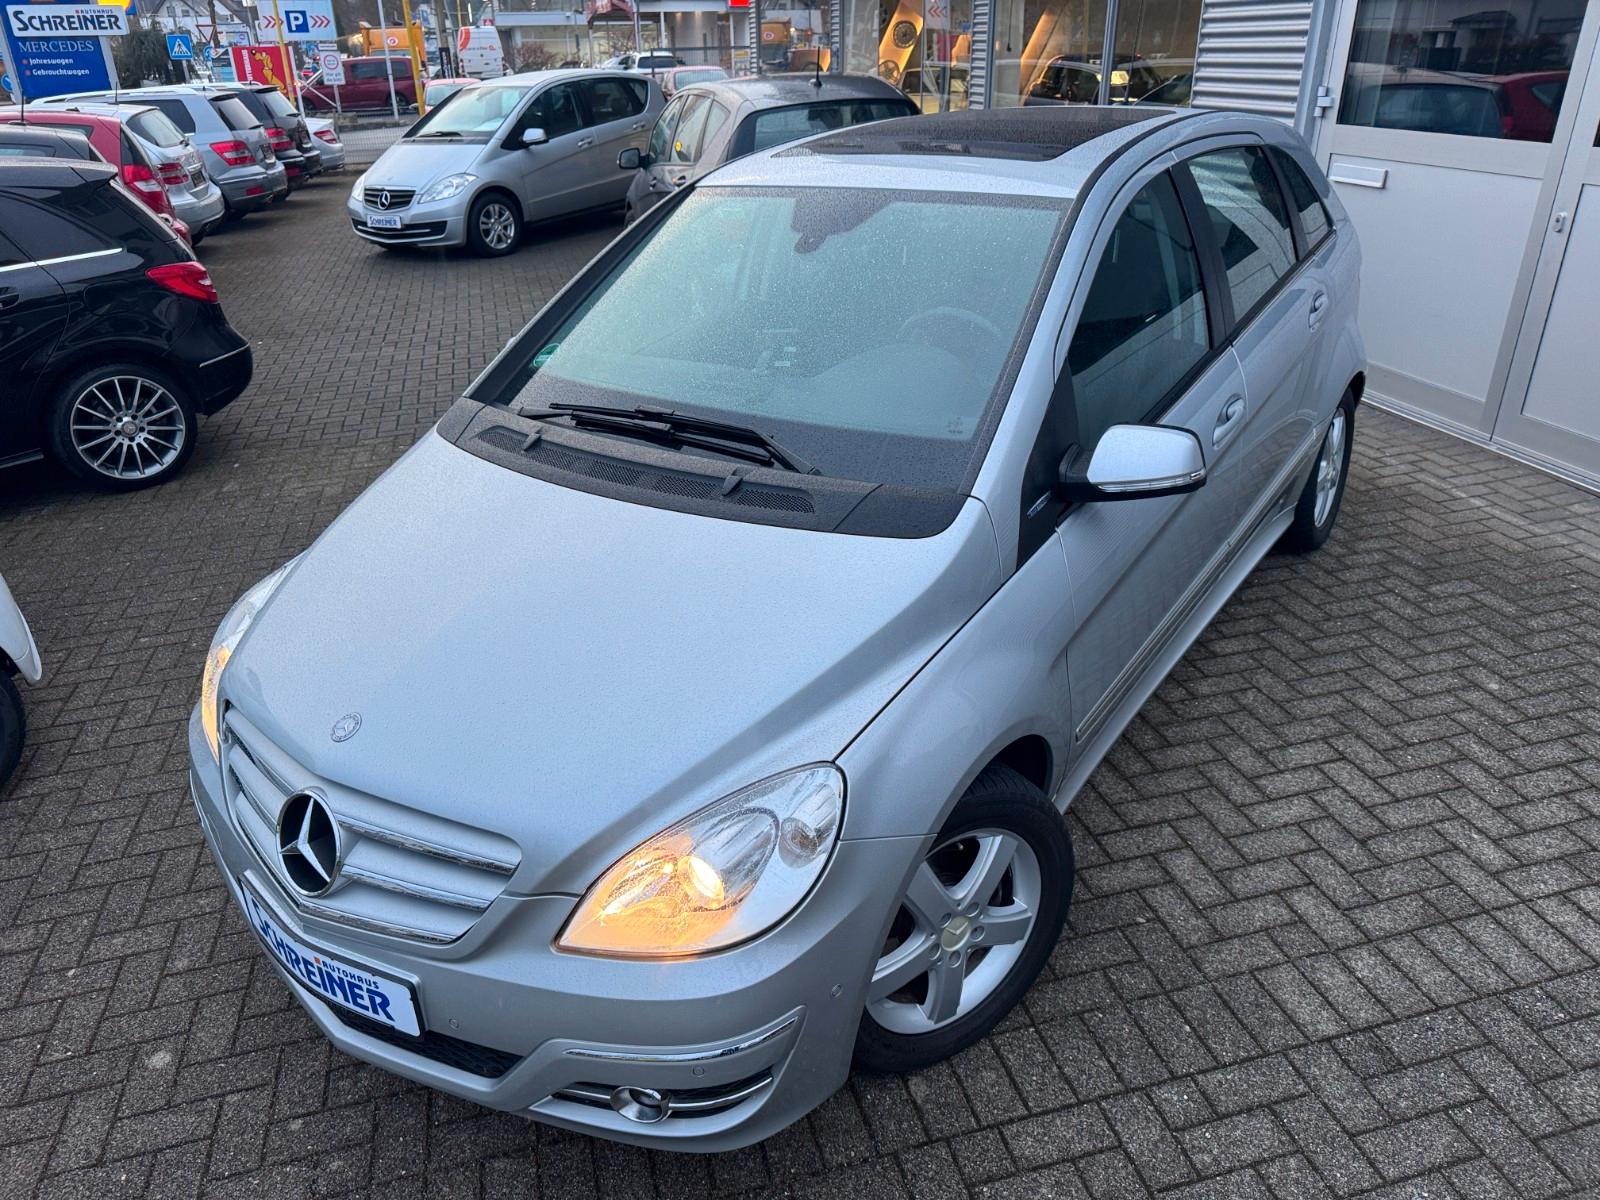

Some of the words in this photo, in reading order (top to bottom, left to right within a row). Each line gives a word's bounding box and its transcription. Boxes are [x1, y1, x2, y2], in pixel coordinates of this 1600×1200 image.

[12, 10, 123, 32] SCHREINER
[289, 12, 304, 31] P
[18, 40, 94, 53] MERCEDES
[29, 58, 74, 66] Jahreswagen
[251, 897, 396, 1022] SCHREINER
[322, 960, 380, 989] AUTOHAUS
